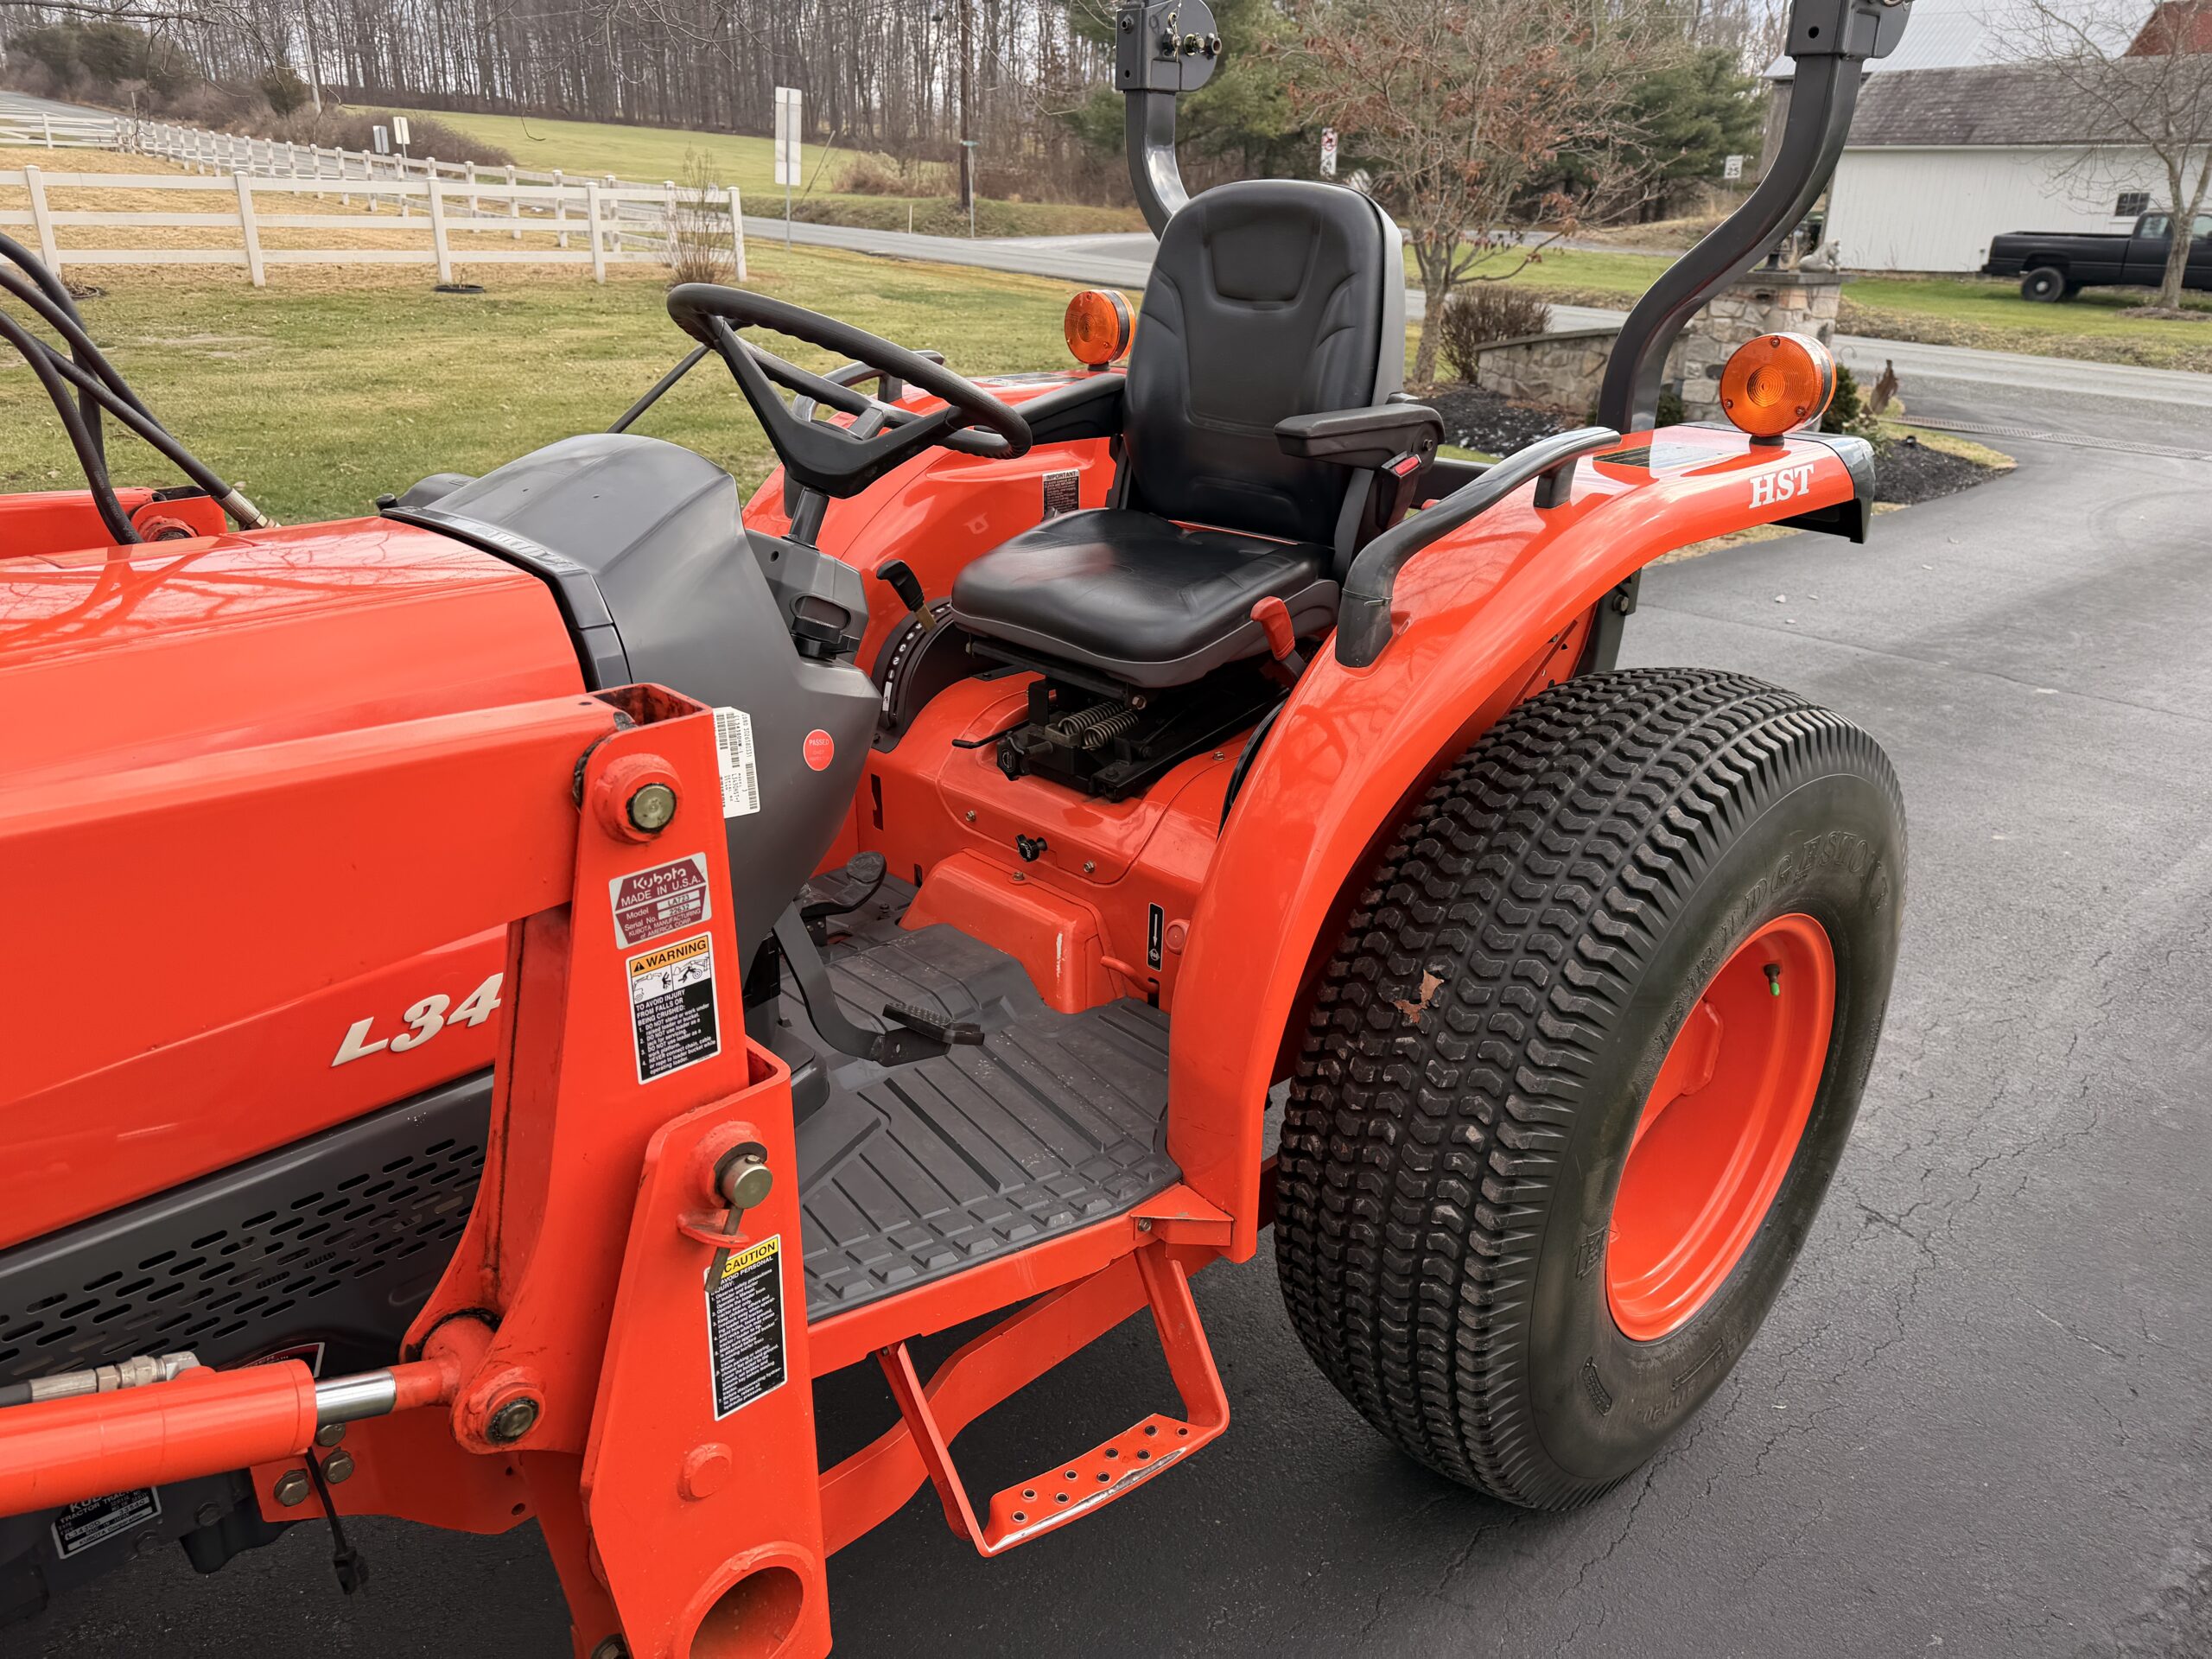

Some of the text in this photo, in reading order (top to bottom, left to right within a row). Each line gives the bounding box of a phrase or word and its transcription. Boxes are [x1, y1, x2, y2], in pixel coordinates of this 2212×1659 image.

[1046, 471, 1076, 480] IMPORTANT
[1748, 464, 1815, 509] HST
[893, 657, 899, 665] 2
[899, 644, 906, 652] 3
[632, 868, 686, 888] Kubota
[620, 875, 700, 906] MADE IN U.S.A.
[626, 894, 689, 919] Model LA723
[624, 919, 643, 931] Serial
[628, 908, 700, 936] KUBOTA MANUFACTURING
[647, 924, 672, 936] AMERICA
[646, 940, 705, 966] WARNING
[645, 996, 663, 1007] AVOID
[664, 988, 684, 1001] INJURY
[330, 971, 505, 1067] L34
[637, 1007, 653, 1018] FROM
[655, 1001, 673, 1012] FALLS
[638, 1005, 684, 1026] BEING CRUSHED:
[664, 1014, 677, 1022] stand
[675, 1021, 690, 1030] loader
[649, 1053, 664, 1063] NEVER
[666, 1046, 684, 1056] connect
[672, 1051, 686, 1059] loader
[688, 1044, 702, 1053] bucket
[650, 1062, 671, 1074] operating
[725, 1242, 775, 1273] CAUTION
[720, 1255, 772, 1284] AVOID PERSONAL
[60, 1503, 100, 1523] TRACTOR
[79, 1529, 105, 1544] KUBOTA
[107, 1512, 143, 1531] Corporation
